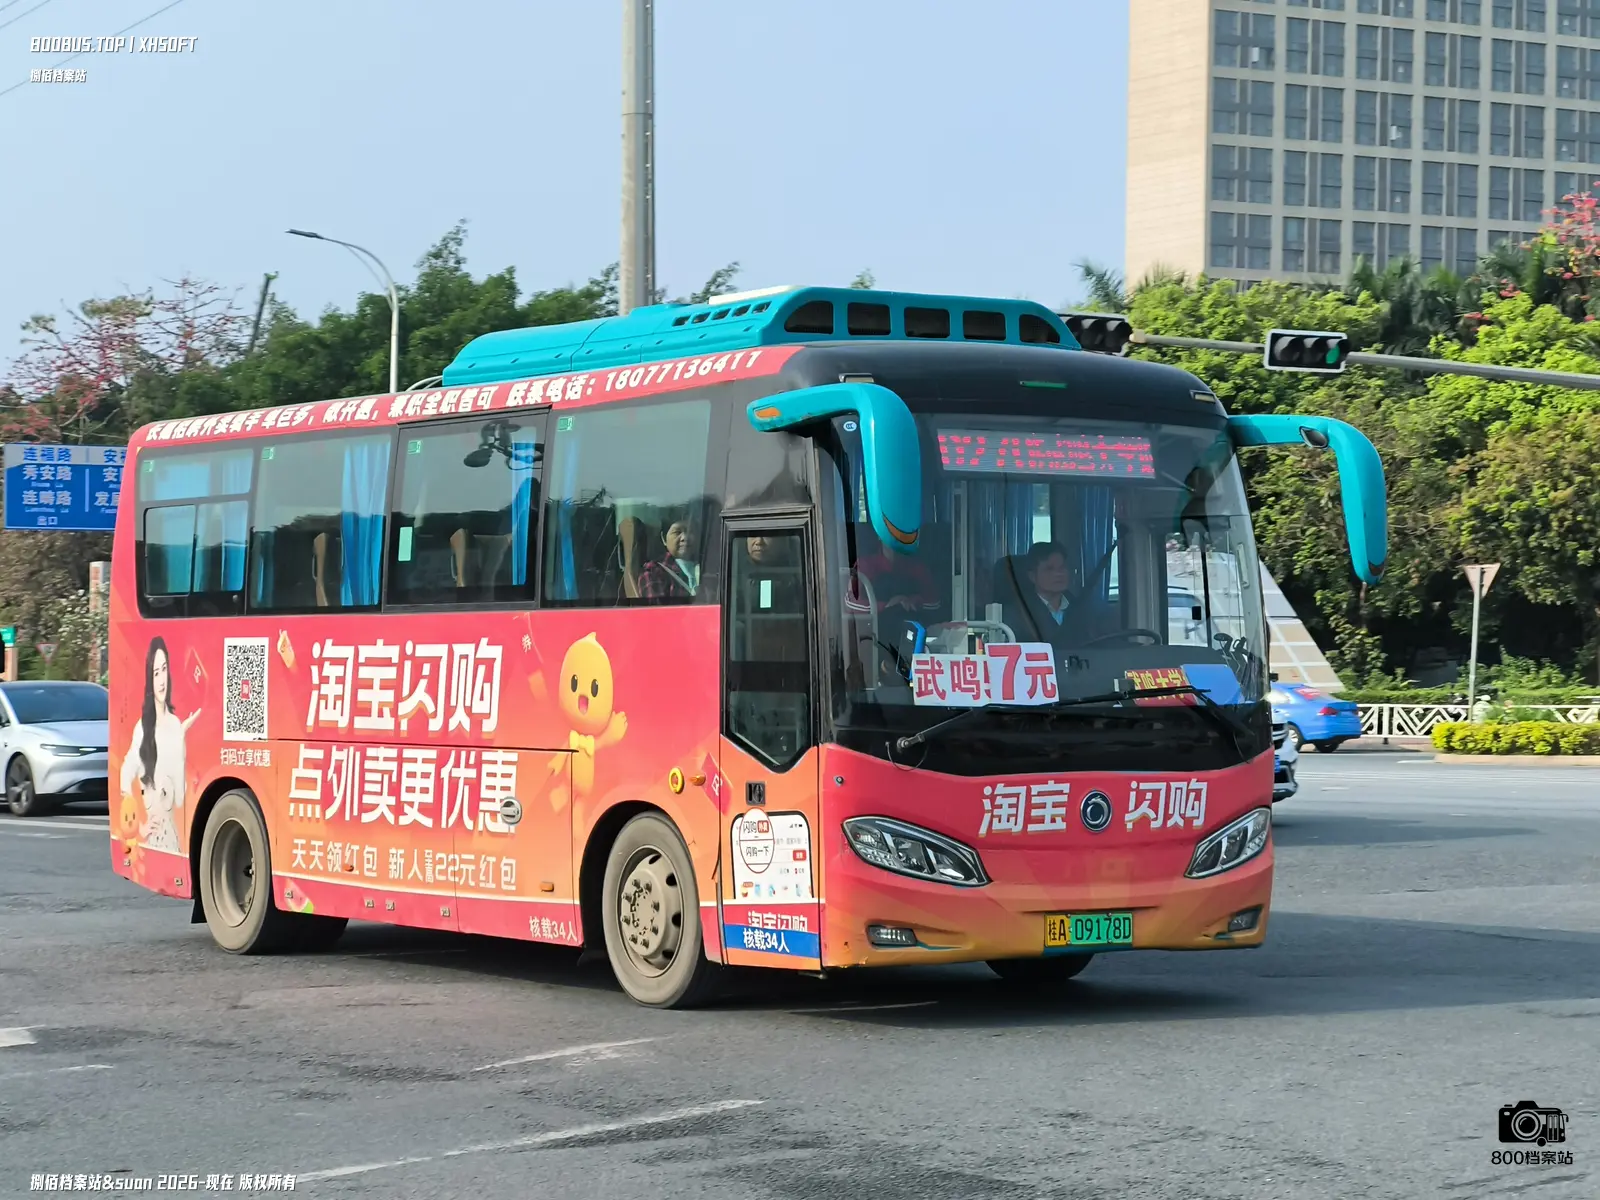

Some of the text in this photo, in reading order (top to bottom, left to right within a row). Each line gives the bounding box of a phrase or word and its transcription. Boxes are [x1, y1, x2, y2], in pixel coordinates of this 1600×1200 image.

[306, 637, 503, 735] 淘宝闪购
[220, 748, 271, 767] 扫码立享优惠
[288, 743, 519, 834] 点外卖更优惠
[978, 778, 1208, 837] 淘宝 闪购
[292, 838, 378, 878] 天天领红包
[529, 915, 578, 943] 核载34人
[747, 910, 808, 932] 淘宝闪购
[1074, 915, 1132, 942] 09178D
[743, 927, 790, 953] 核载34人
